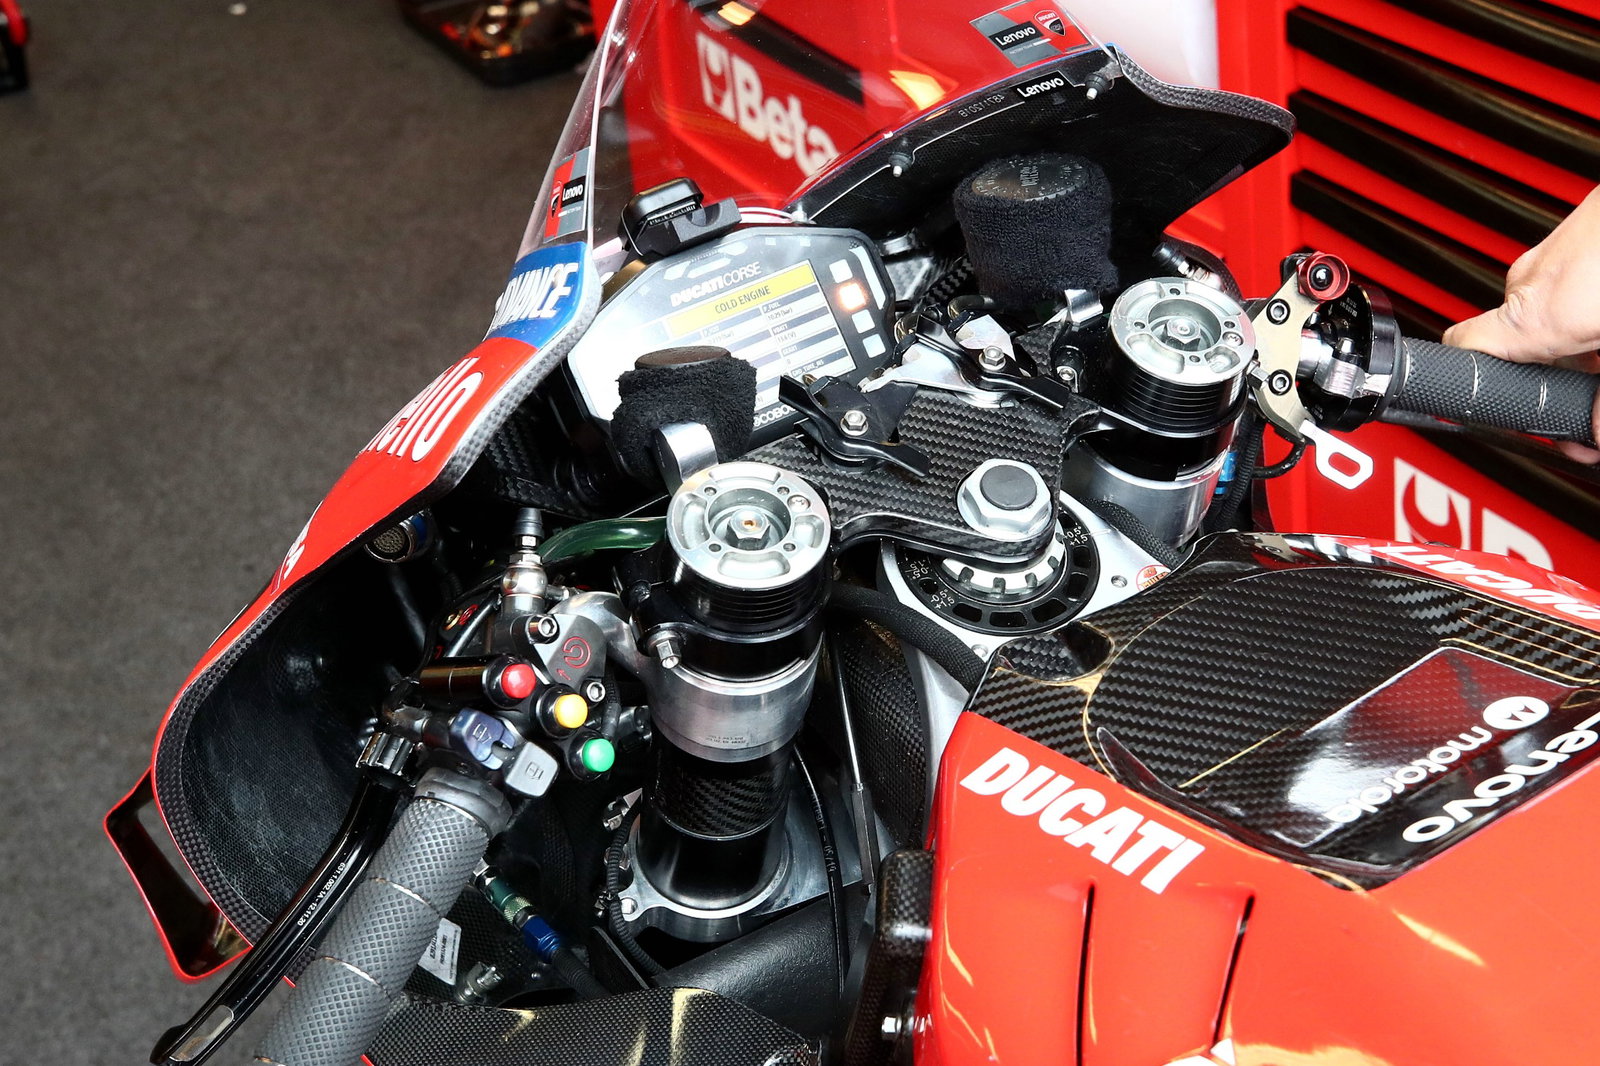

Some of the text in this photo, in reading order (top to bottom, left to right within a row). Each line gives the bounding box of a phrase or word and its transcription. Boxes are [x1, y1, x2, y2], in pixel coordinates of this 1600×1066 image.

[995, 26, 1036, 46] Lenovo
[1016, 77, 1064, 98] Lenovo
[730, 53, 840, 177] Beta
[562, 184, 584, 202] Lenovo
[714, 285, 771, 314] COLD ENGINE
[1324, 726, 1493, 823] motorola
[959, 747, 1206, 895] DUCATI
[296, 902, 318, 926] 12.11.20
